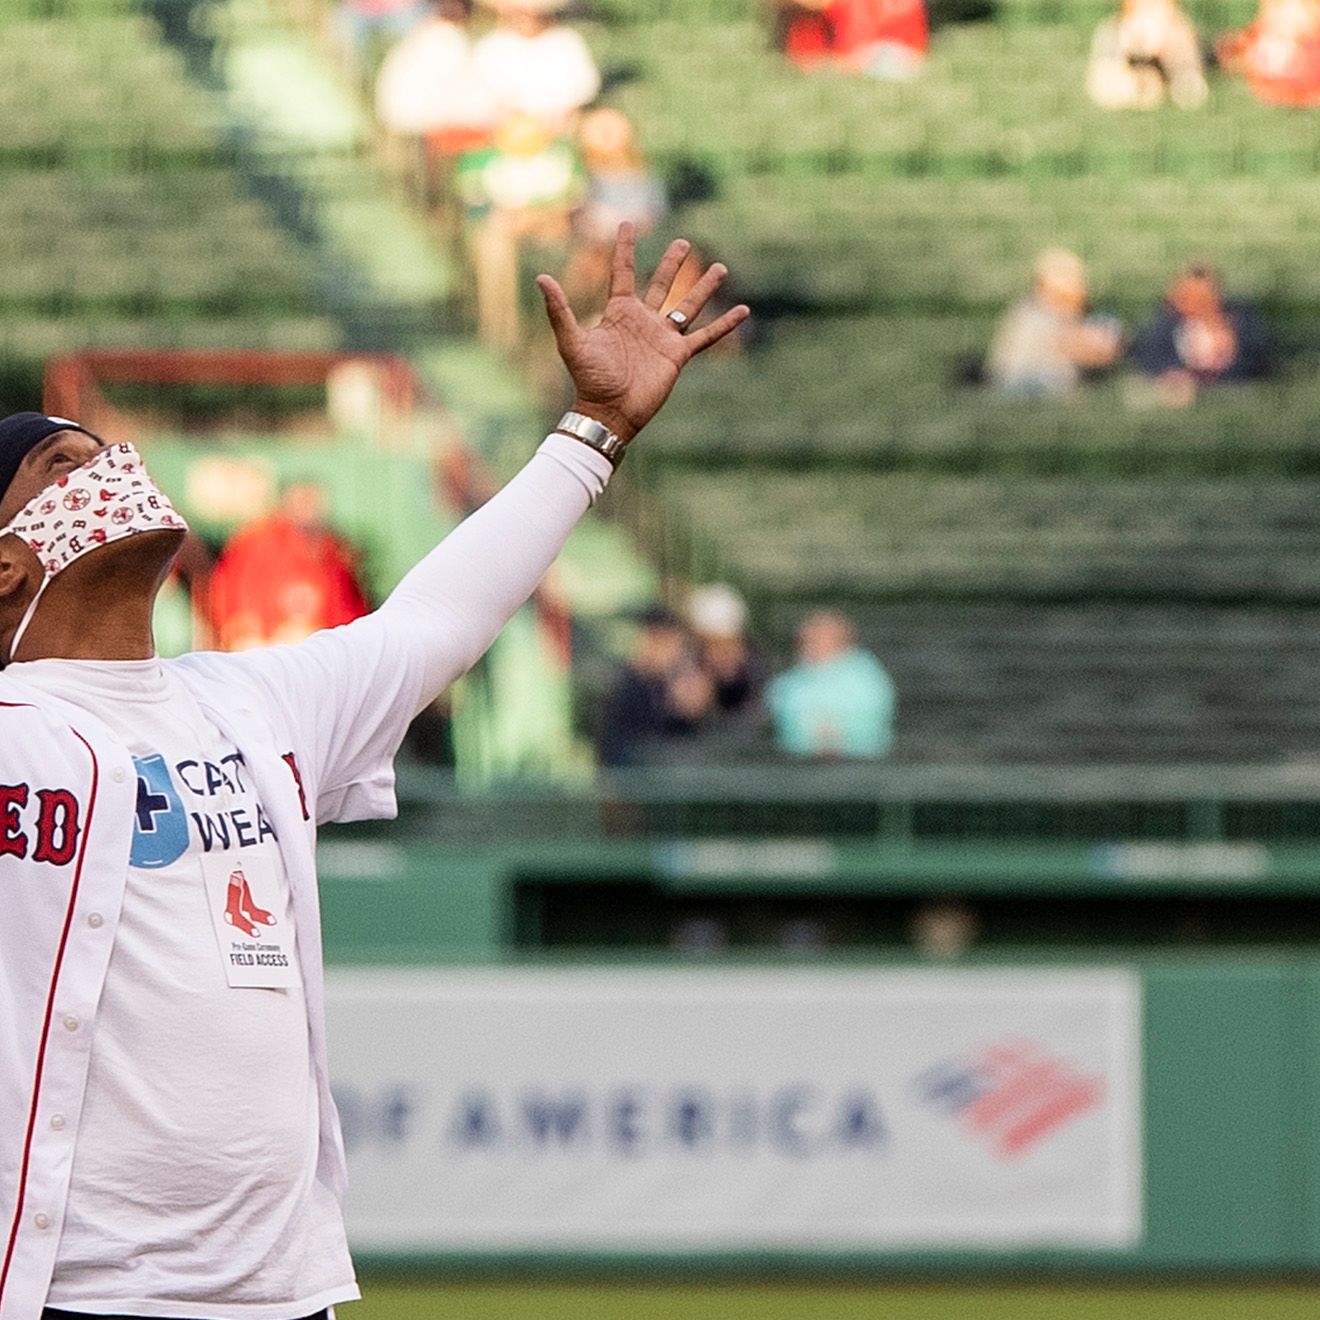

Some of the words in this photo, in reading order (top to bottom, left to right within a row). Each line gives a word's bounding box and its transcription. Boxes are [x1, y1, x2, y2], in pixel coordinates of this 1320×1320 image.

[176, 752, 246, 796] CAT
[191, 802, 278, 852] WEA
[230, 953, 255, 966] FIELD
[256, 954, 289, 967] ACCESS
[450, 1083, 888, 1162] AMERICA
